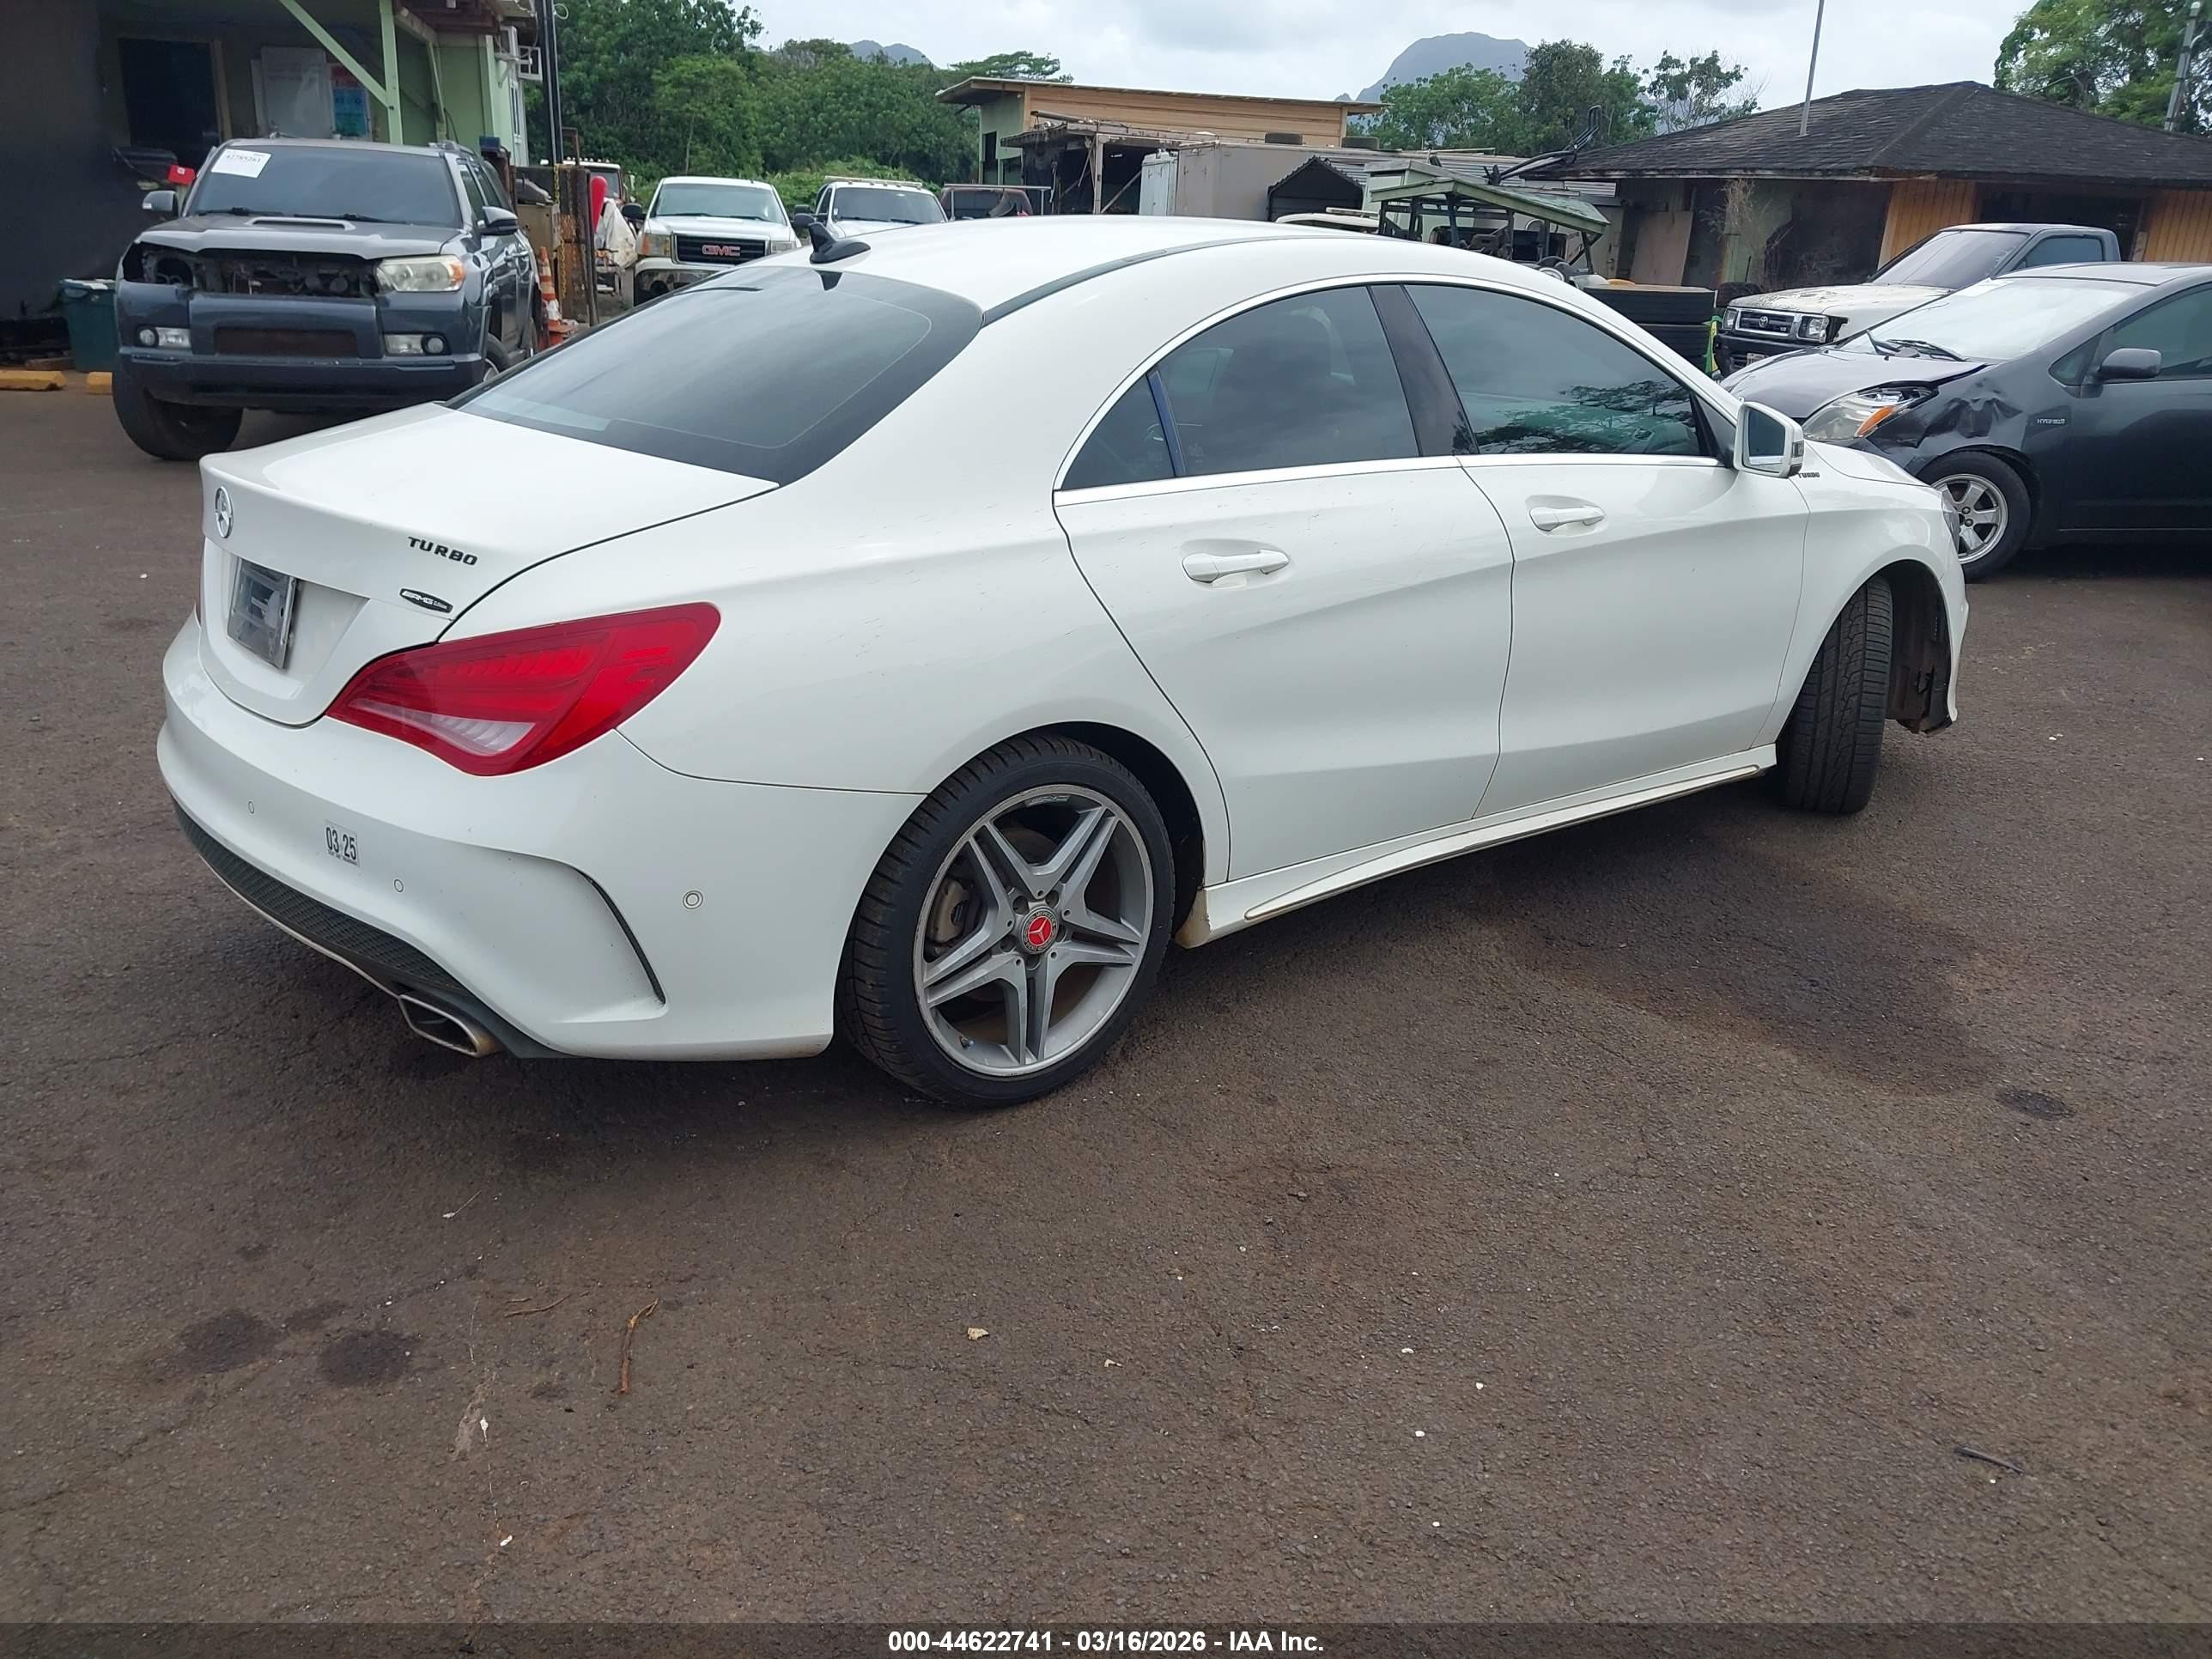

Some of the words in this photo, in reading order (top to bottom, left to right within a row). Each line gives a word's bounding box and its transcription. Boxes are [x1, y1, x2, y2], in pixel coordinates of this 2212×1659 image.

[702, 244, 741, 257] GMC
[408, 536, 477, 565] TURBO
[326, 827, 339, 853] 03
[343, 834, 356, 860] 25
